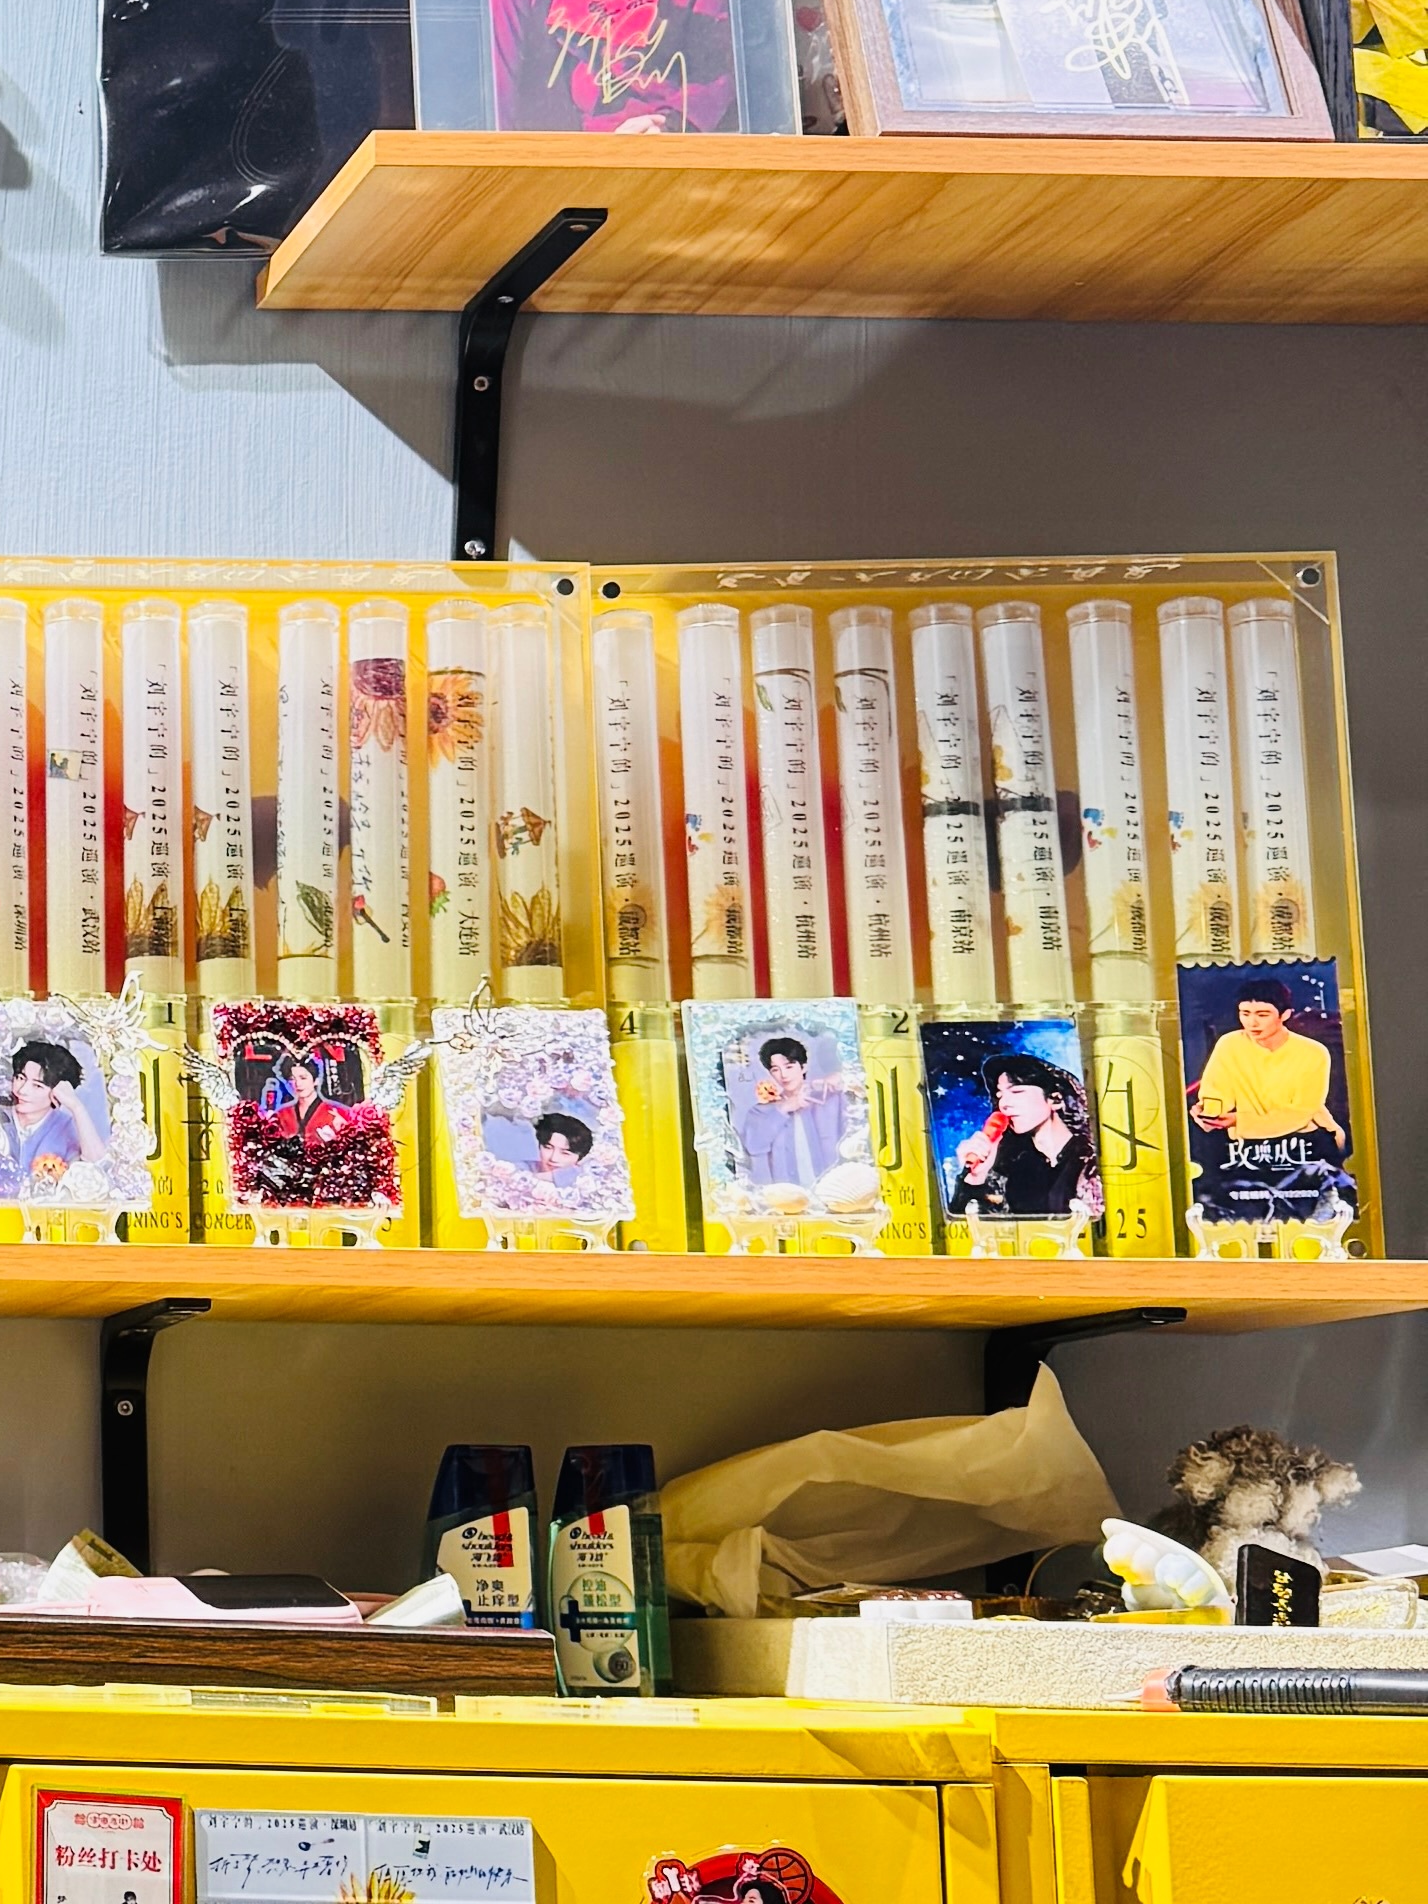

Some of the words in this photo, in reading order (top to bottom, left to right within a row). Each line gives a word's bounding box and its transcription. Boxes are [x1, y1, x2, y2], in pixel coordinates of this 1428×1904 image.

[164, 1002, 176, 1025] 1
[619, 1011, 639, 1035] 4
[891, 1011, 910, 1034] 2
[193, 1213, 256, 1231] CONCER
[475, 1579, 504, 1593] 净爽
[582, 1578, 607, 1592] 控油
[478, 1594, 520, 1607] 止痒型
[54, 1844, 163, 1873] 粉丝打卡处
